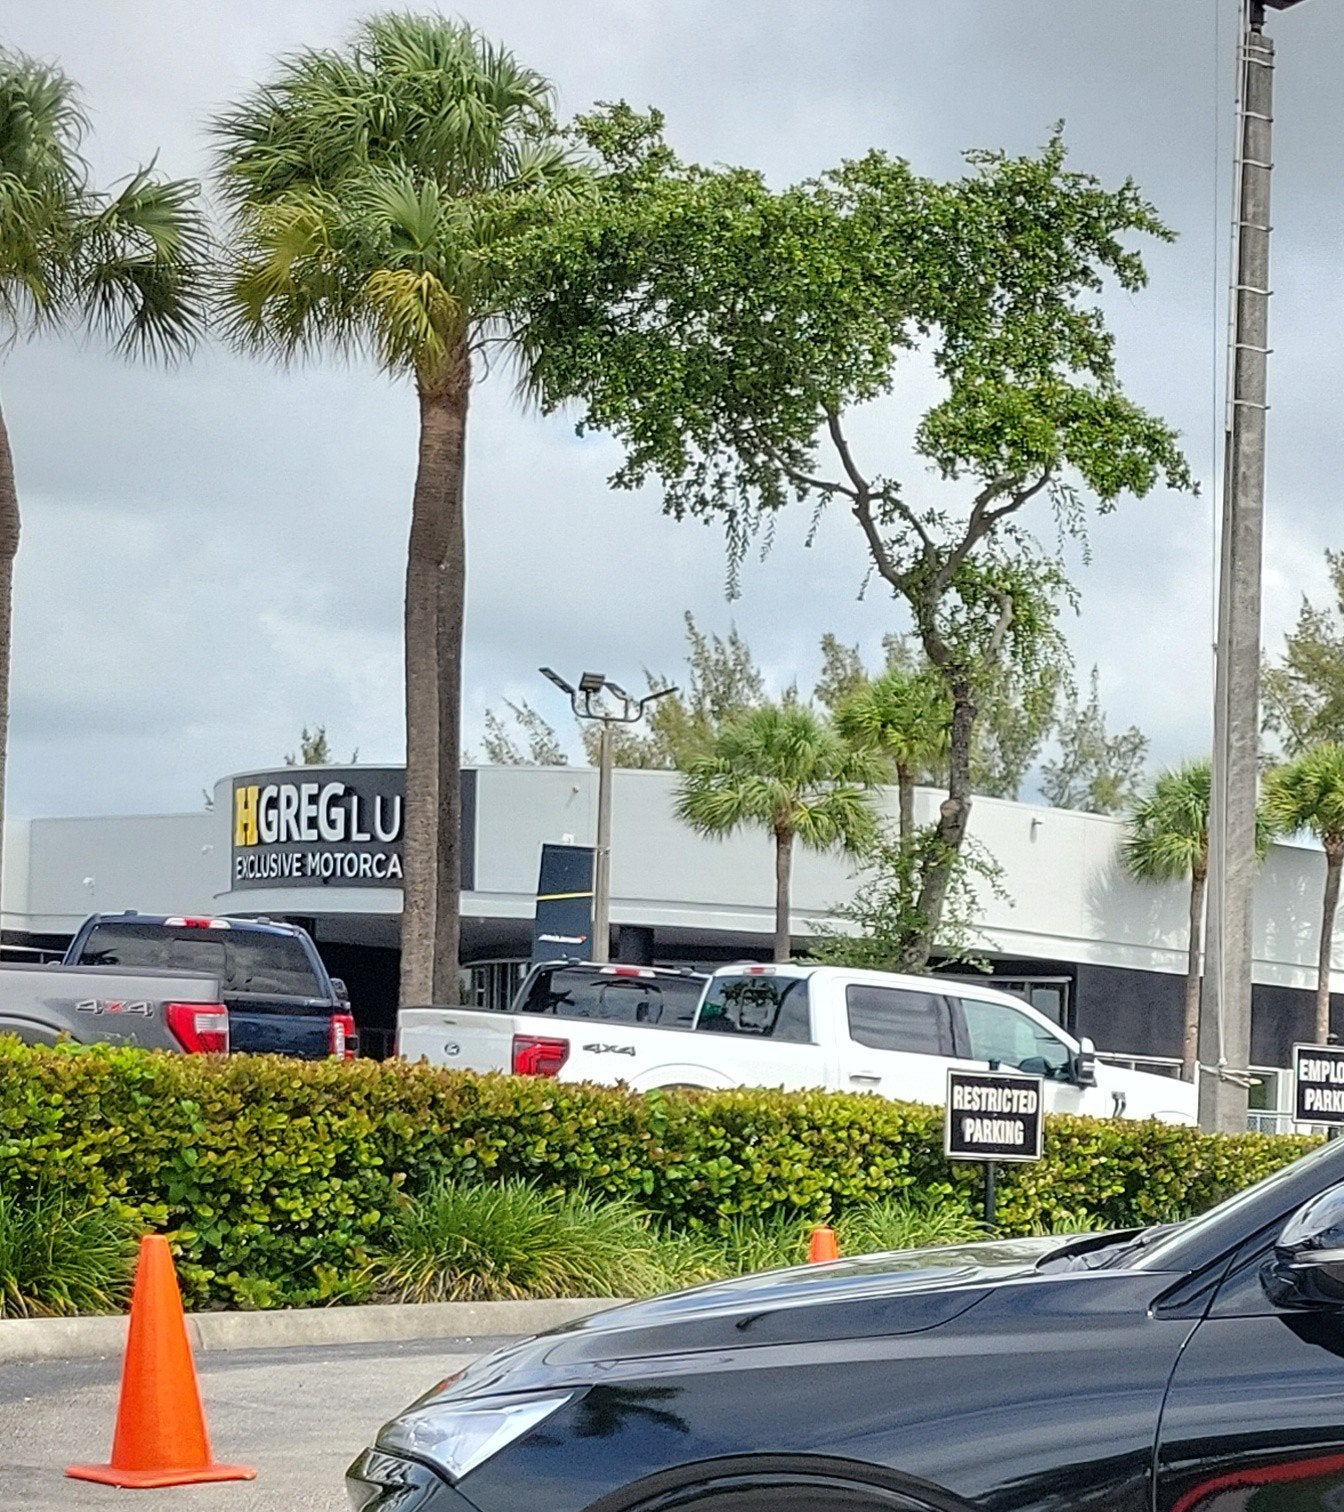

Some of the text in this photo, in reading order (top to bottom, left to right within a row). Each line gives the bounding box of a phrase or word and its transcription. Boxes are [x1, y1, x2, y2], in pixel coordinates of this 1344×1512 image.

[235, 852, 303, 880] EXCLUSIVE
[952, 1084, 1038, 1115] RESTRICTED
[962, 1116, 1025, 1145] PARKING
